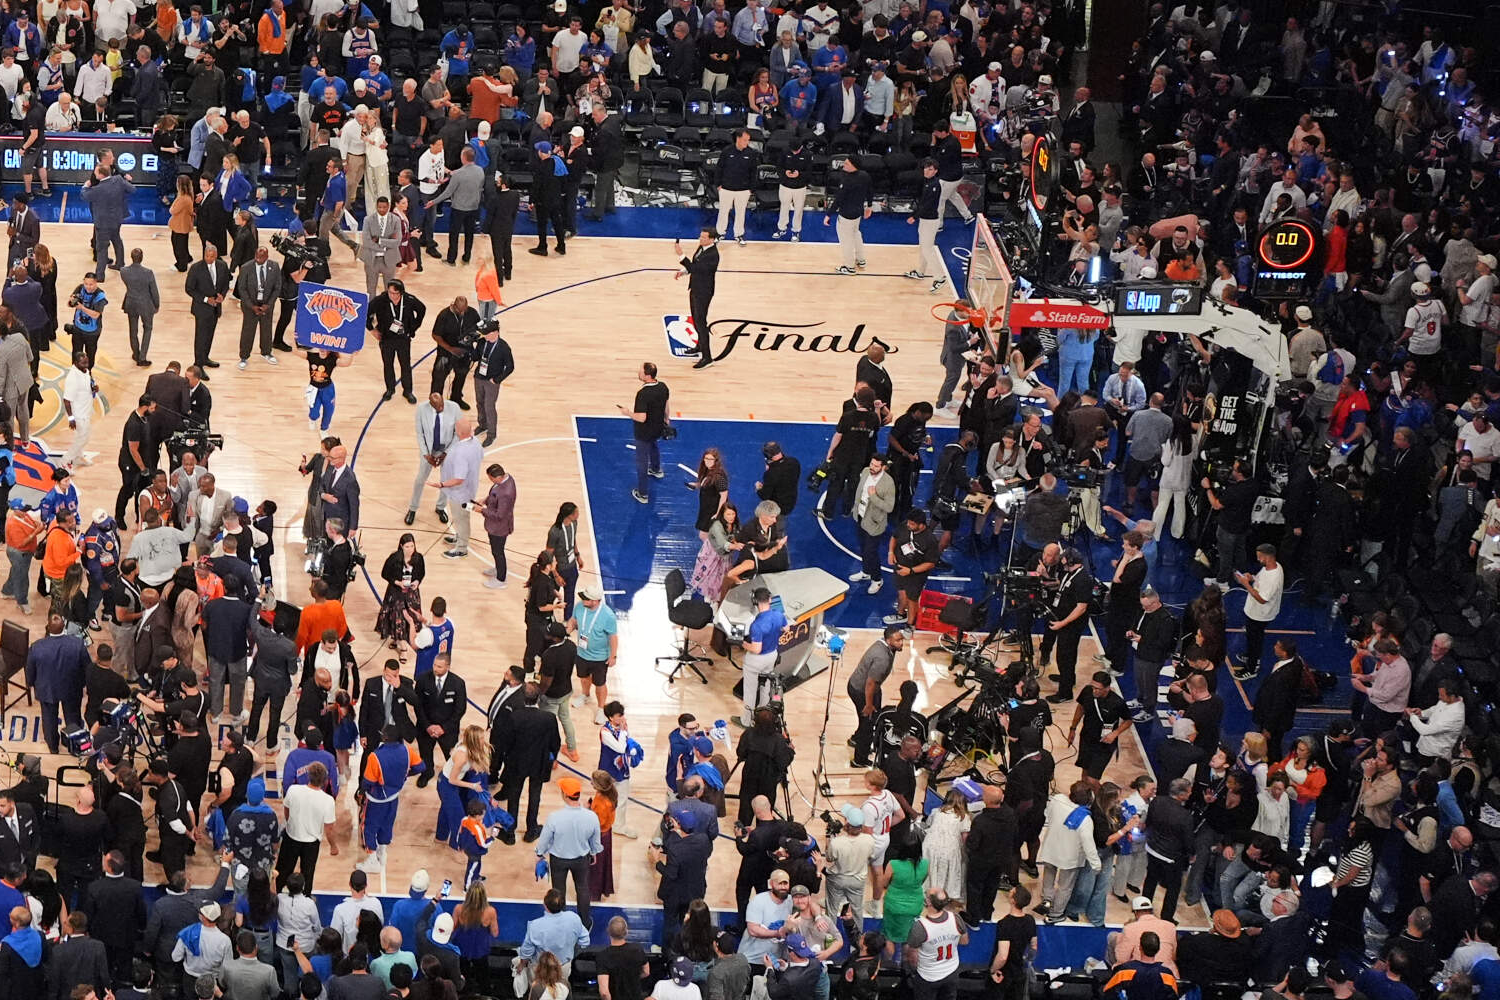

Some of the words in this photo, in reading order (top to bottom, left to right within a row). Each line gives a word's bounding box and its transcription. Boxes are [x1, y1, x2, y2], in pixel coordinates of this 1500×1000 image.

[52, 150, 94, 170] 8:30PM
[1275, 232, 1299, 246] 0.0
[1272, 272, 1306, 280] TISSOT
[307, 292, 357, 317] KNICKS
[1136, 291, 1161, 312] App
[310, 331, 348, 349] WIN!
[707, 318, 899, 362] Finals
[1221, 395, 1239, 408] GET
[1220, 407, 1237, 420] THE
[1220, 420, 1238, 436] App
[936, 943, 953, 961] 11
